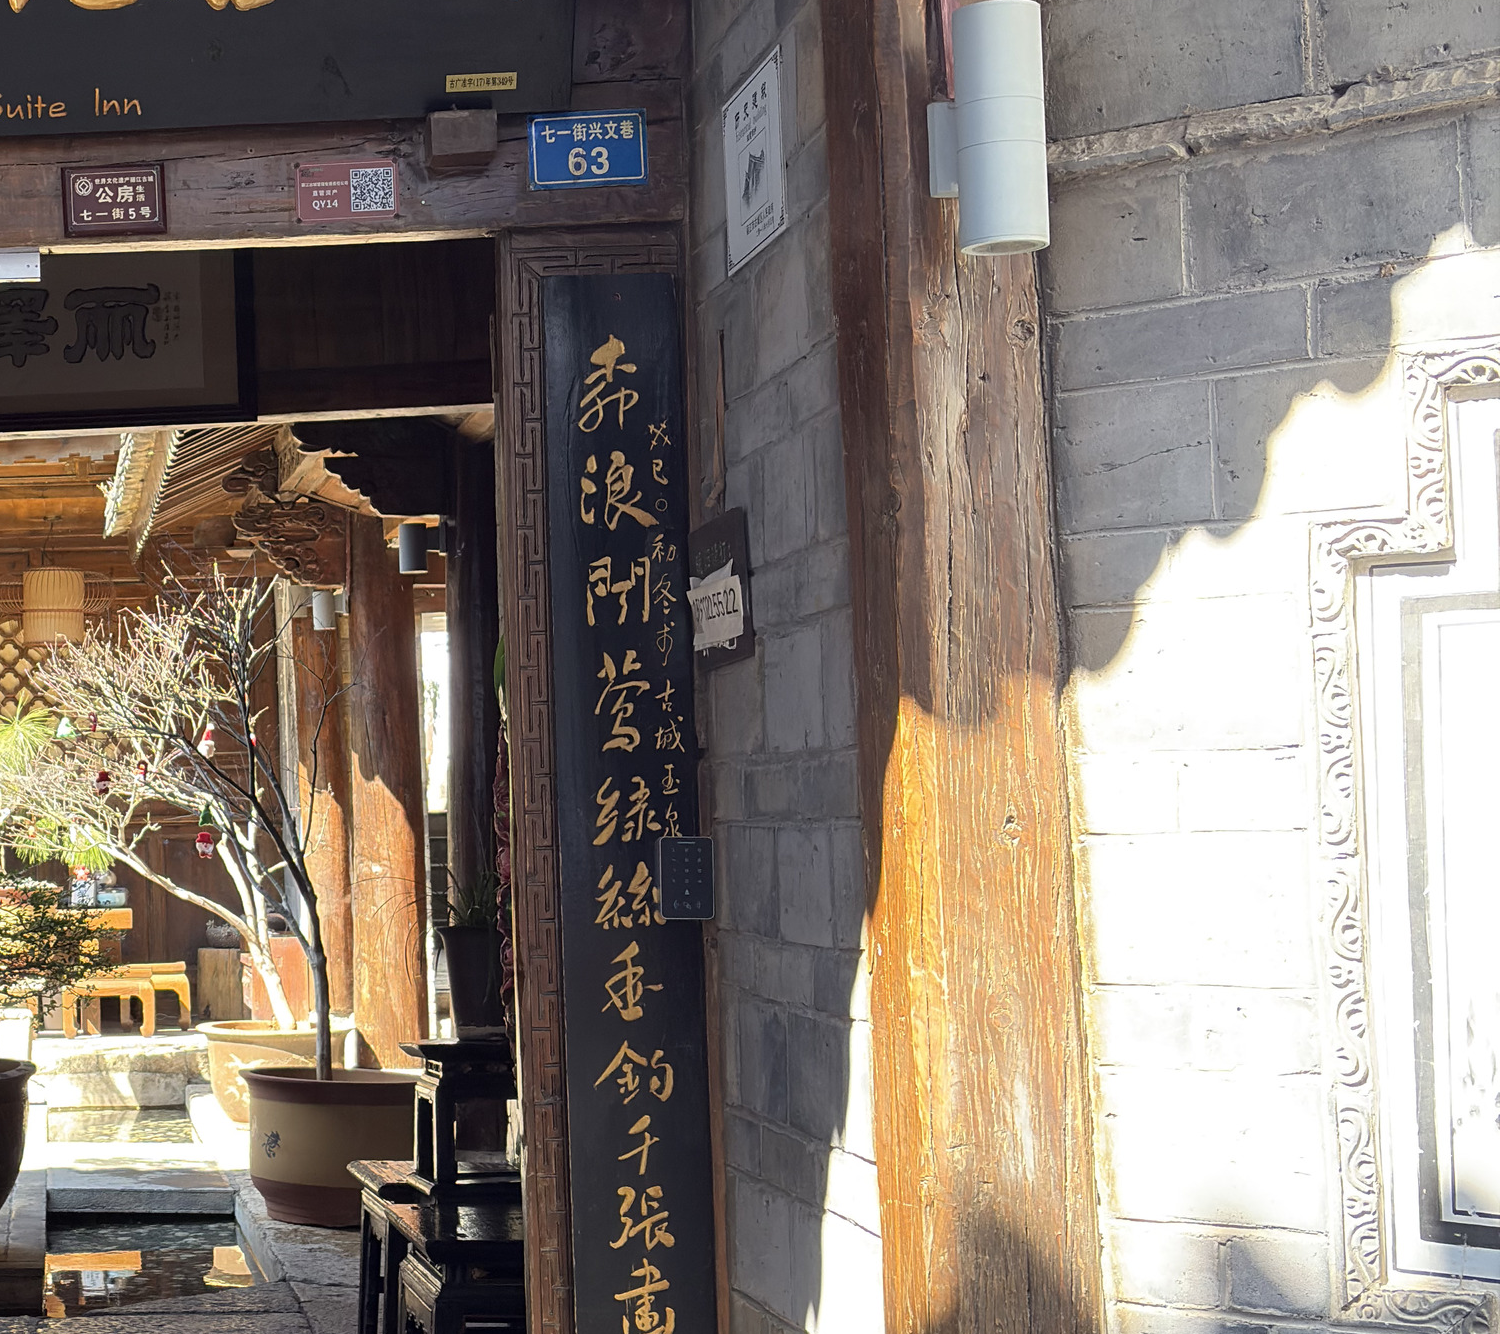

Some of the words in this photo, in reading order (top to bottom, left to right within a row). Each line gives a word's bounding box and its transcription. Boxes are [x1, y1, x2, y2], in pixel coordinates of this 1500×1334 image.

[95, 88, 141, 116] Inn
[541, 120, 634, 143] 七一街兴文巷
[568, 146, 610, 176] 63
[95, 185, 135, 203] 公房
[135, 185, 146, 202] 生活
[80, 206, 152, 221] 七一街5号
[312, 199, 339, 210] QY14
